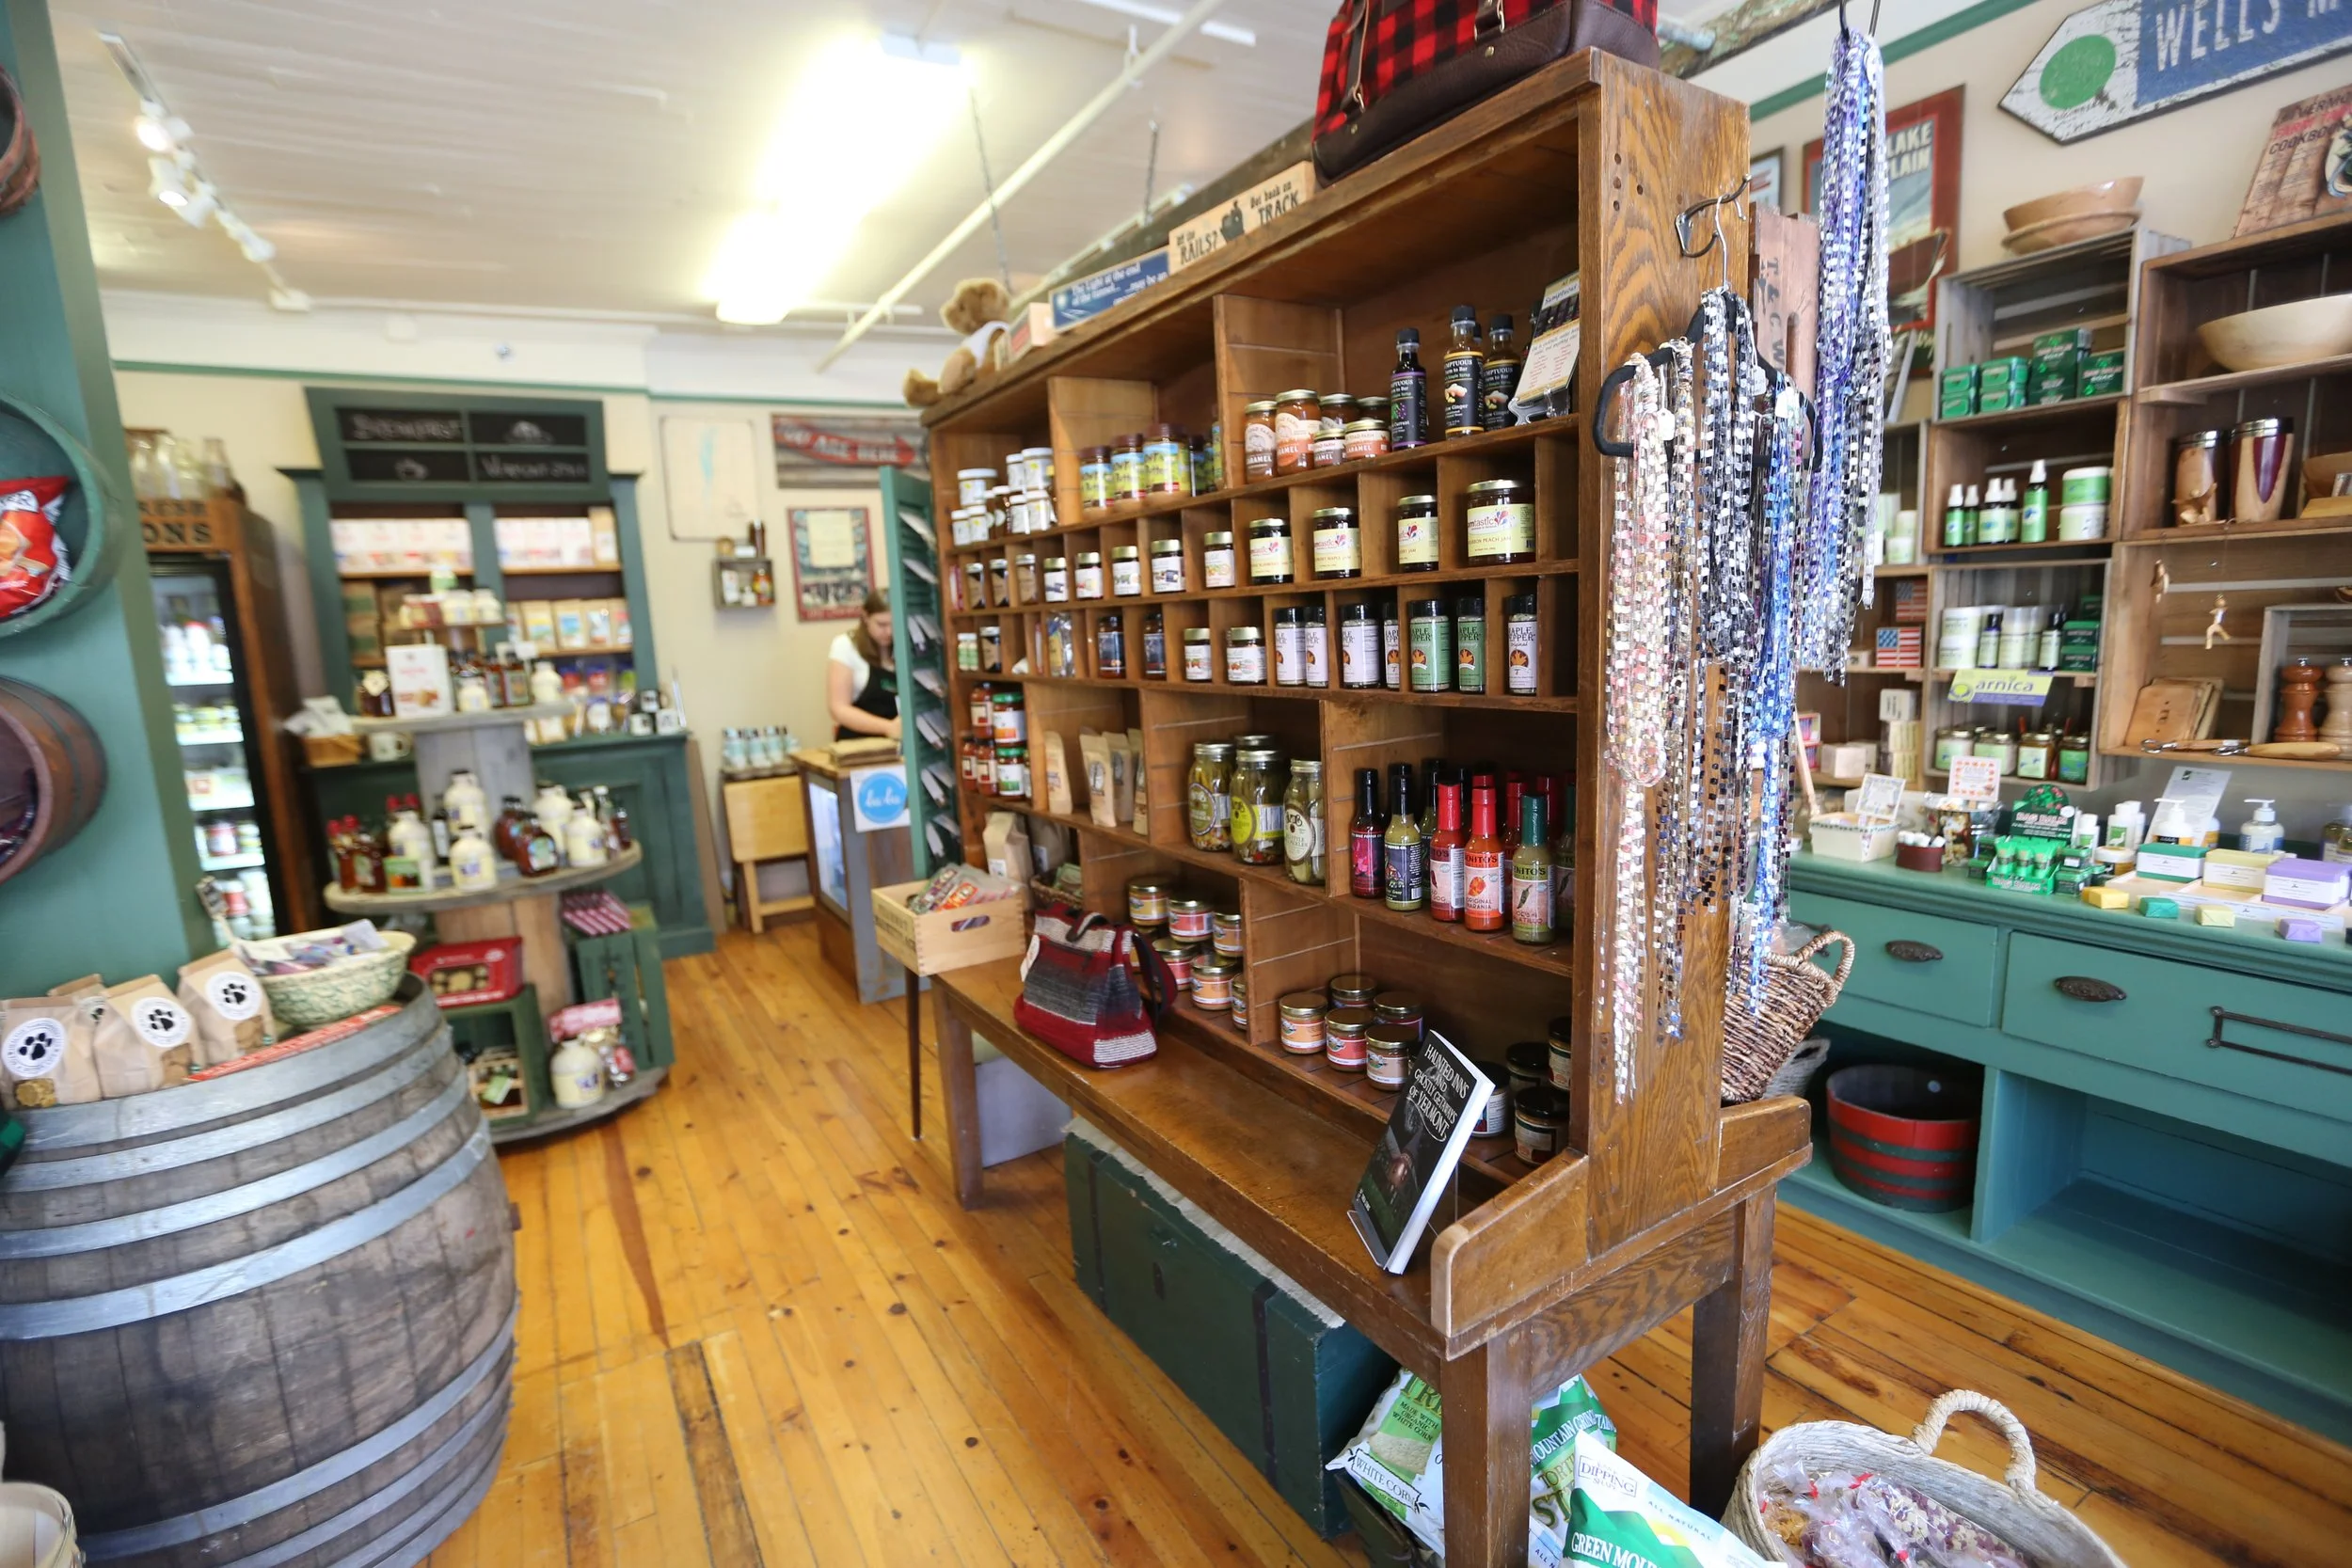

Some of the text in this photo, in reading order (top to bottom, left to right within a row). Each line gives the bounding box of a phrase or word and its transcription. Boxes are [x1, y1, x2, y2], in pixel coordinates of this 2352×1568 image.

[2156, 0, 2280, 71] WELLS
[1885, 120, 1932, 158] LAKE
[1889, 146, 1931, 181] LAIN
[1258, 190, 1298, 225] TRACK
[1446, 358, 1473, 368] MPTUOUS
[1486, 367, 1513, 376] MPTUOUS
[1391, 378, 1413, 388] PTUOUS
[1347, 444, 1372, 453] ARAMEL
[142, 522, 212, 544] ONS
[1468, 515, 1494, 528] mtastic
[1412, 627, 1429, 637] APLE
[1459, 626, 1478, 636] APLE
[1976, 676, 2033, 692] arnica
[1466, 854, 1498, 863] ENITO'S
[1513, 865, 1546, 876] ENITO'S
[1424, 1043, 1470, 1100] HAUNTED INNS
[1435, 1074, 1448, 1093] AND
[1414, 1069, 1458, 1125] GHOSTLY GETAWAYS
[1409, 1085, 1450, 1137] OF VERMONT
[1391, 1411, 1434, 1442] WHITE CORN
[1400, 1401, 1439, 1431] MADE WITH
[1401, 1410, 1431, 1433] ORGANIC
[1355, 1457, 1385, 1486] WHITE
[1385, 1479, 1416, 1505] CORN
[1581, 1462, 1635, 1494] DIPPING
[1647, 1500, 1714, 1541] ALL NATURAL
[1534, 1548, 1549, 1562] ALL
[1571, 1531, 1613, 1564] GREEN
